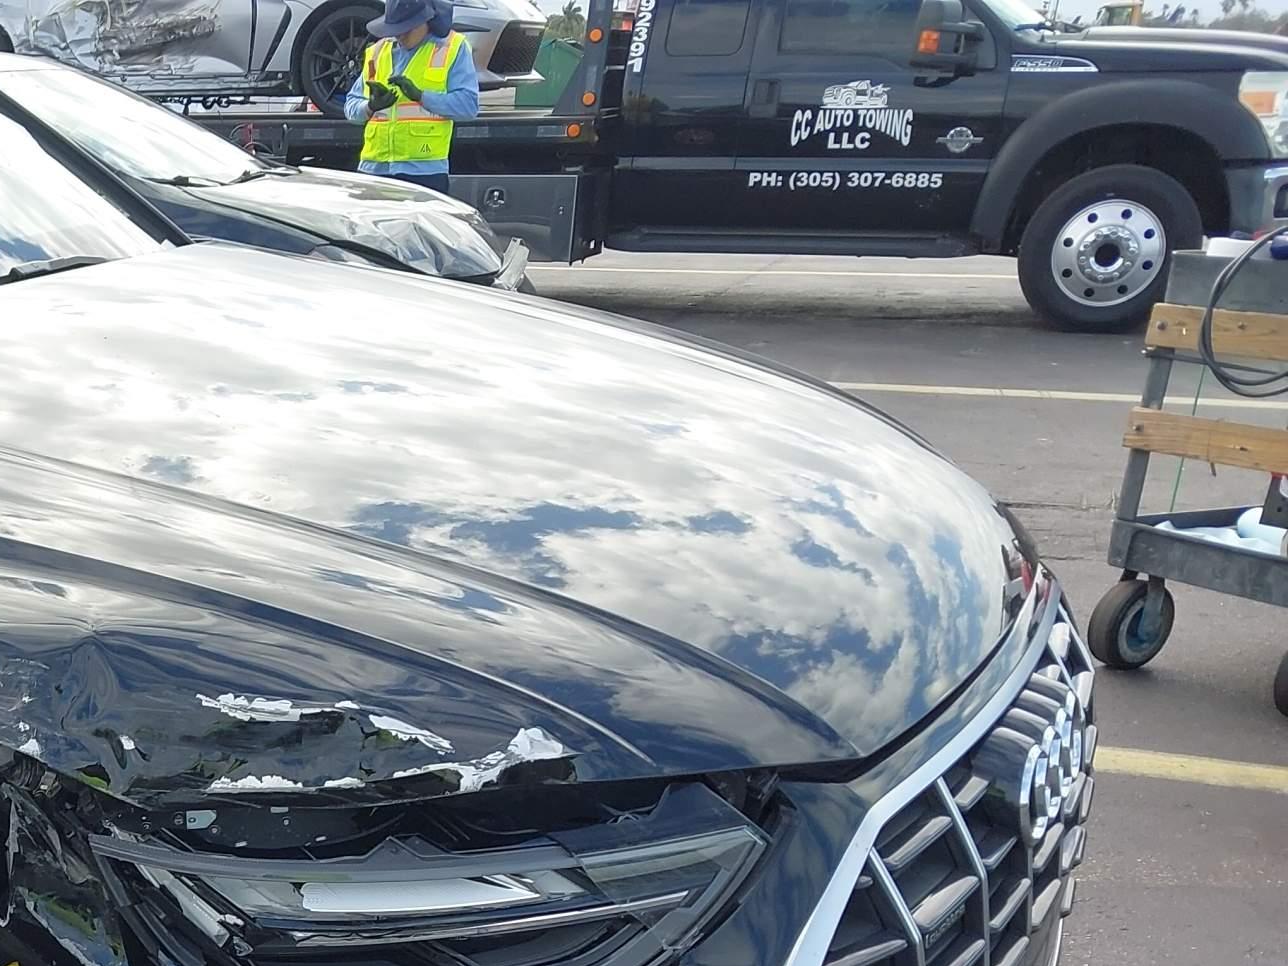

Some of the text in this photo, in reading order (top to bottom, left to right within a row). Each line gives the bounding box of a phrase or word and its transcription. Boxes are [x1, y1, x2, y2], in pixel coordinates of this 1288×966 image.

[791, 108, 914, 147] CC AUTO TOWING
[827, 132, 872, 149] LLC
[748, 171, 943, 191] PH: (305) 307-6885
